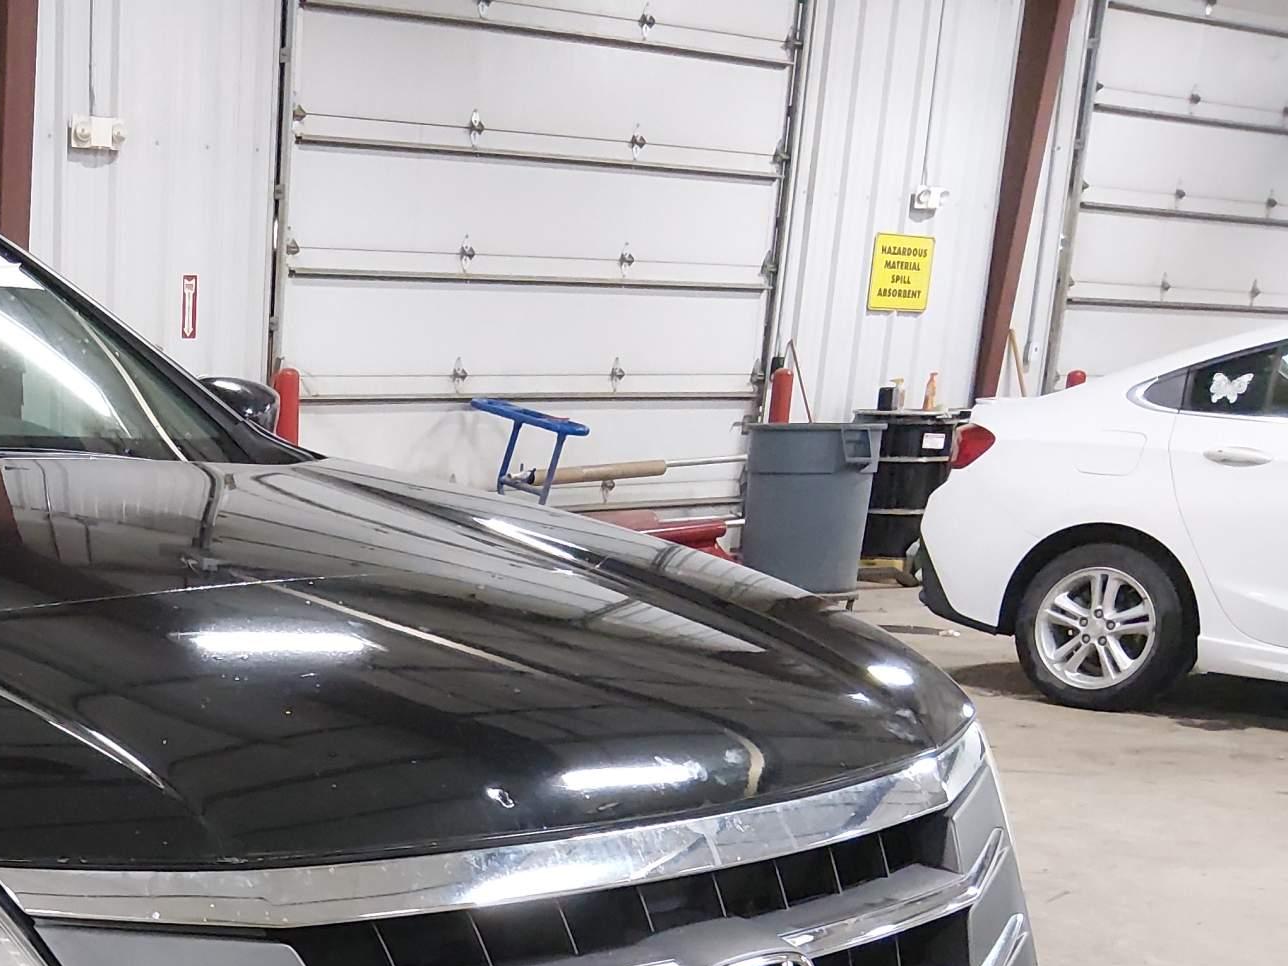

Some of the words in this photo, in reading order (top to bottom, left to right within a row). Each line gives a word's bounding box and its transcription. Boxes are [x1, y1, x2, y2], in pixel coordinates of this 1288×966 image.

[881, 245, 928, 258] HAZARDOUS
[884, 260, 921, 271] MATERIAL
[890, 274, 912, 284] SPILL
[877, 288, 922, 299] ABSORBENT
